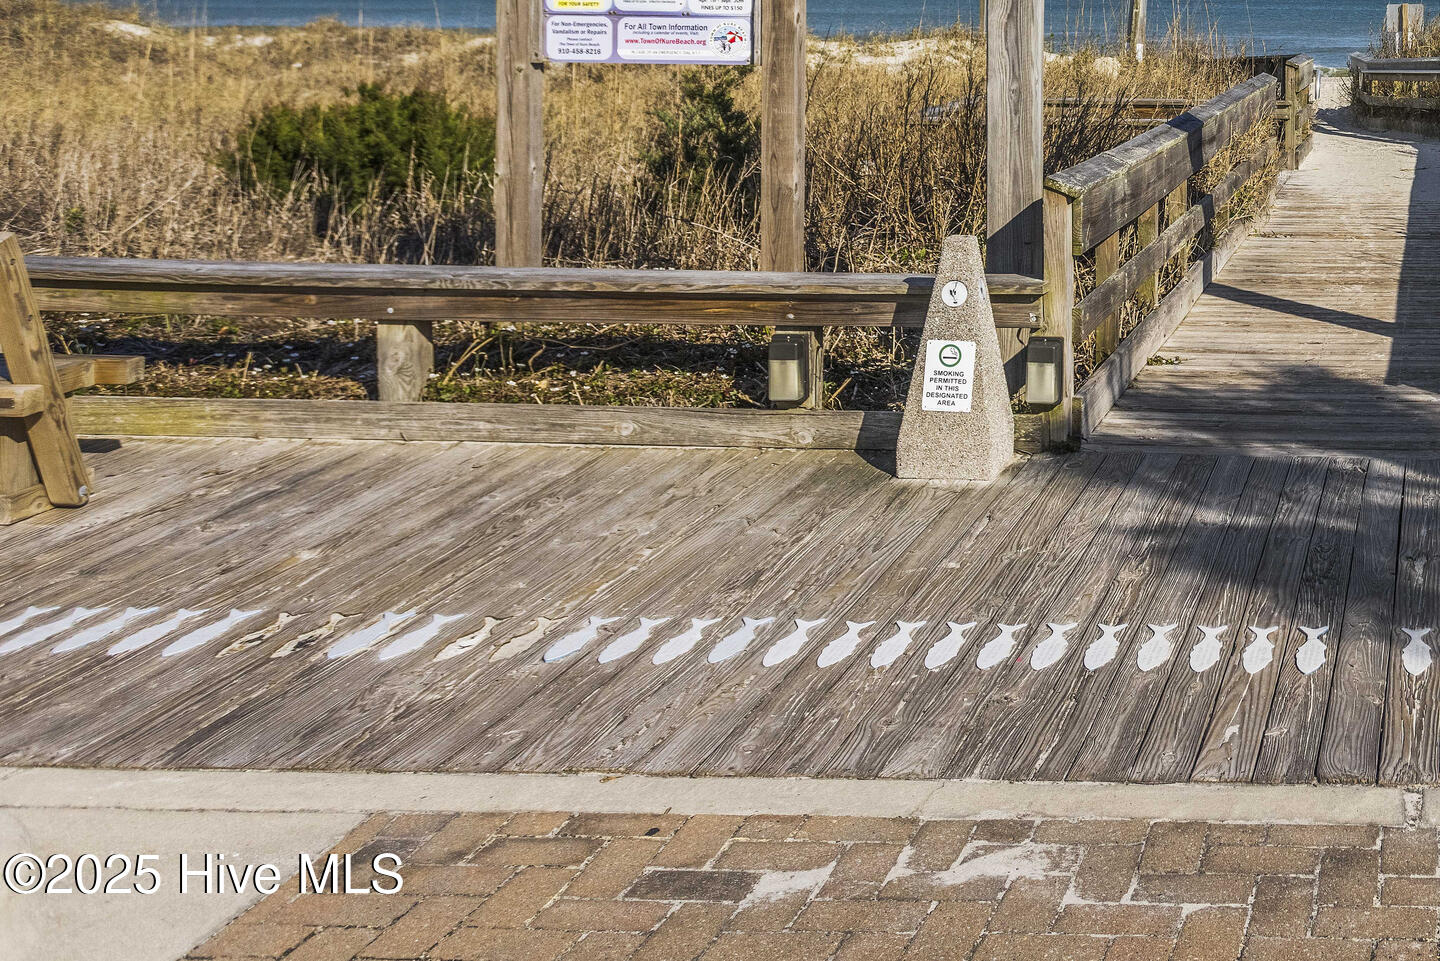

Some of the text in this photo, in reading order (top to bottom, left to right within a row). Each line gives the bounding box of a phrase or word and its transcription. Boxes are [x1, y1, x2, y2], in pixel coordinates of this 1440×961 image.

[624, 22, 636, 30] For
[668, 23, 708, 31] Information
[624, 37, 707, 46] www.TownOfKureBeach.org
[933, 369, 965, 377] SMOKING
[929, 377, 967, 385] PERMITTED
[925, 391, 969, 400] DESIGNATED
[936, 399, 956, 407] AREA
